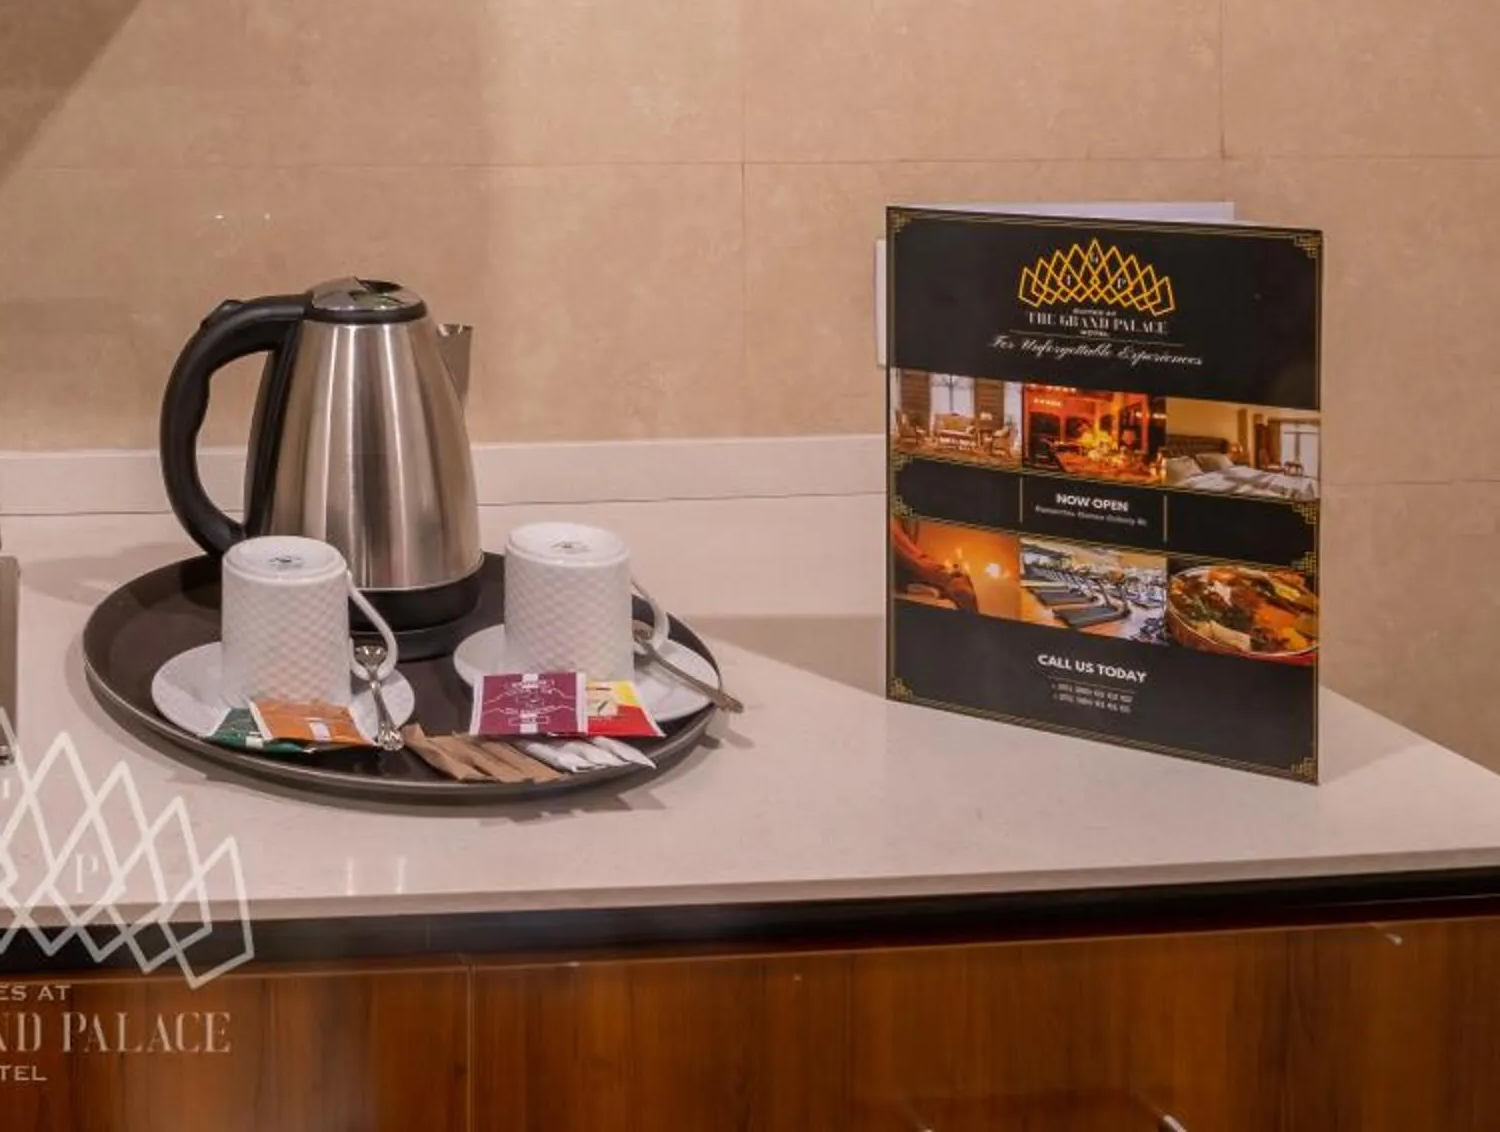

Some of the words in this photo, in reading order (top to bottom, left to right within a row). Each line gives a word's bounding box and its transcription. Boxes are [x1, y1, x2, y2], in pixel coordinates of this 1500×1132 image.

[1026, 312, 1058, 325] THE
[1059, 314, 1110, 329] GRAND
[1113, 317, 1168, 335] PALACE
[991, 335, 1015, 349] For
[1021, 339, 1114, 360] Unforgettable
[1117, 346, 1203, 365] Experiences
[1055, 493, 1091, 508] NOW
[1092, 497, 1129, 512] OPEN
[1037, 654, 1072, 670] CALL
[1075, 660, 1095, 674] US
[1097, 664, 1147, 684] TODAY
